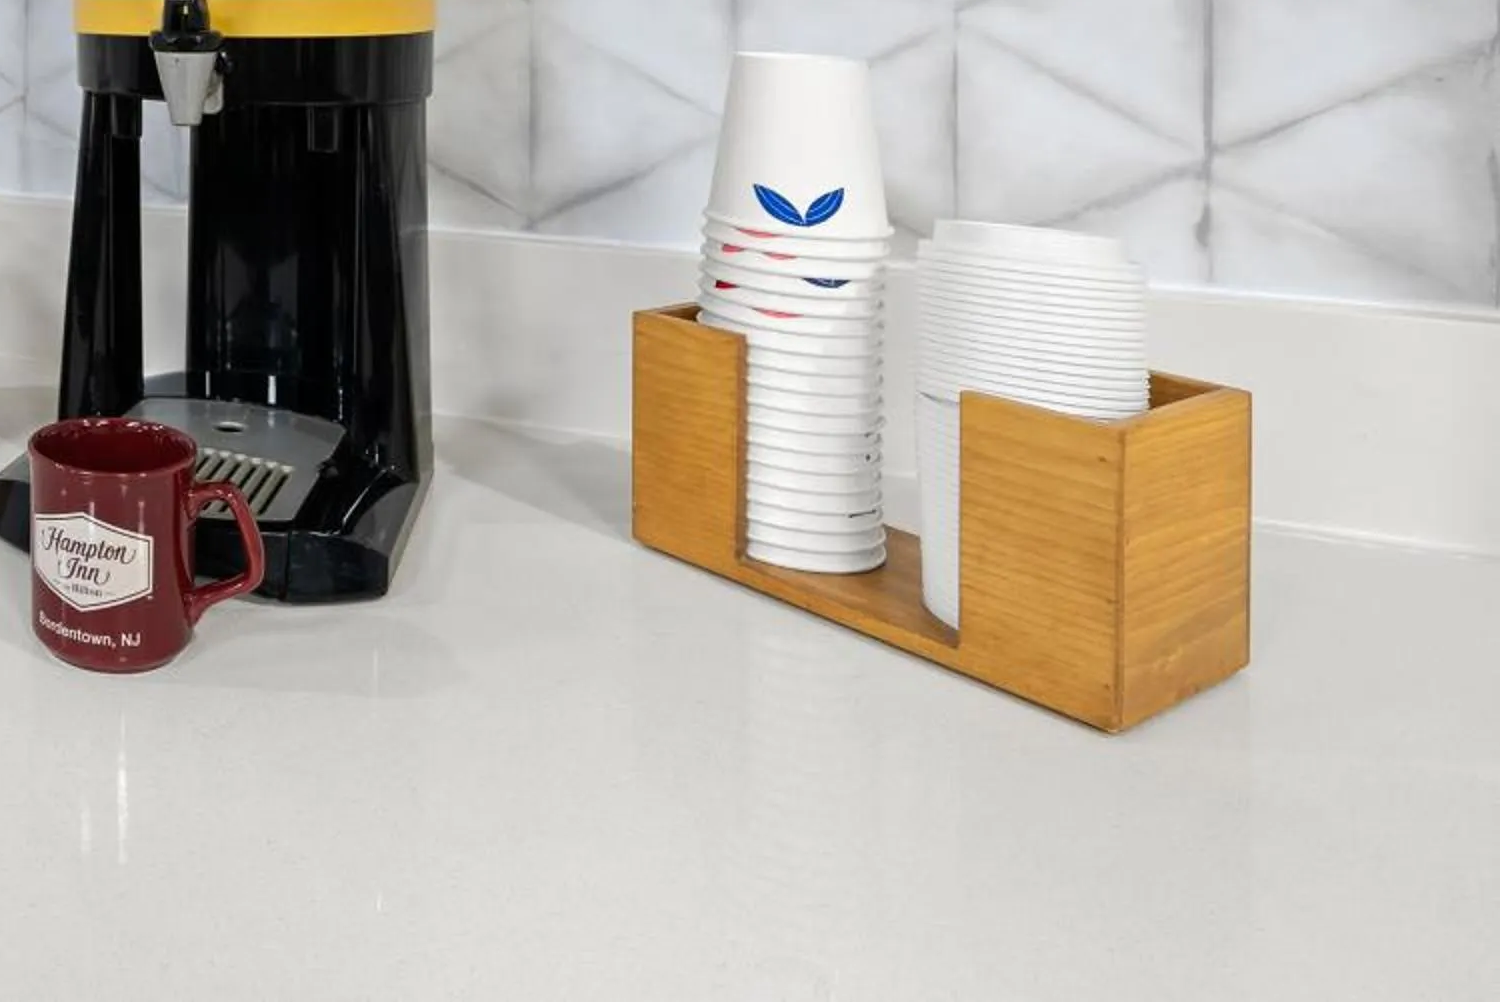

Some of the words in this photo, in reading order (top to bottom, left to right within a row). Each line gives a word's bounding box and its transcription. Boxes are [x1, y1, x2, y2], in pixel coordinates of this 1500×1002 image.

[42, 525, 137, 565] Hampton
[58, 557, 111, 586] Inn
[121, 632, 141, 648] NJ
